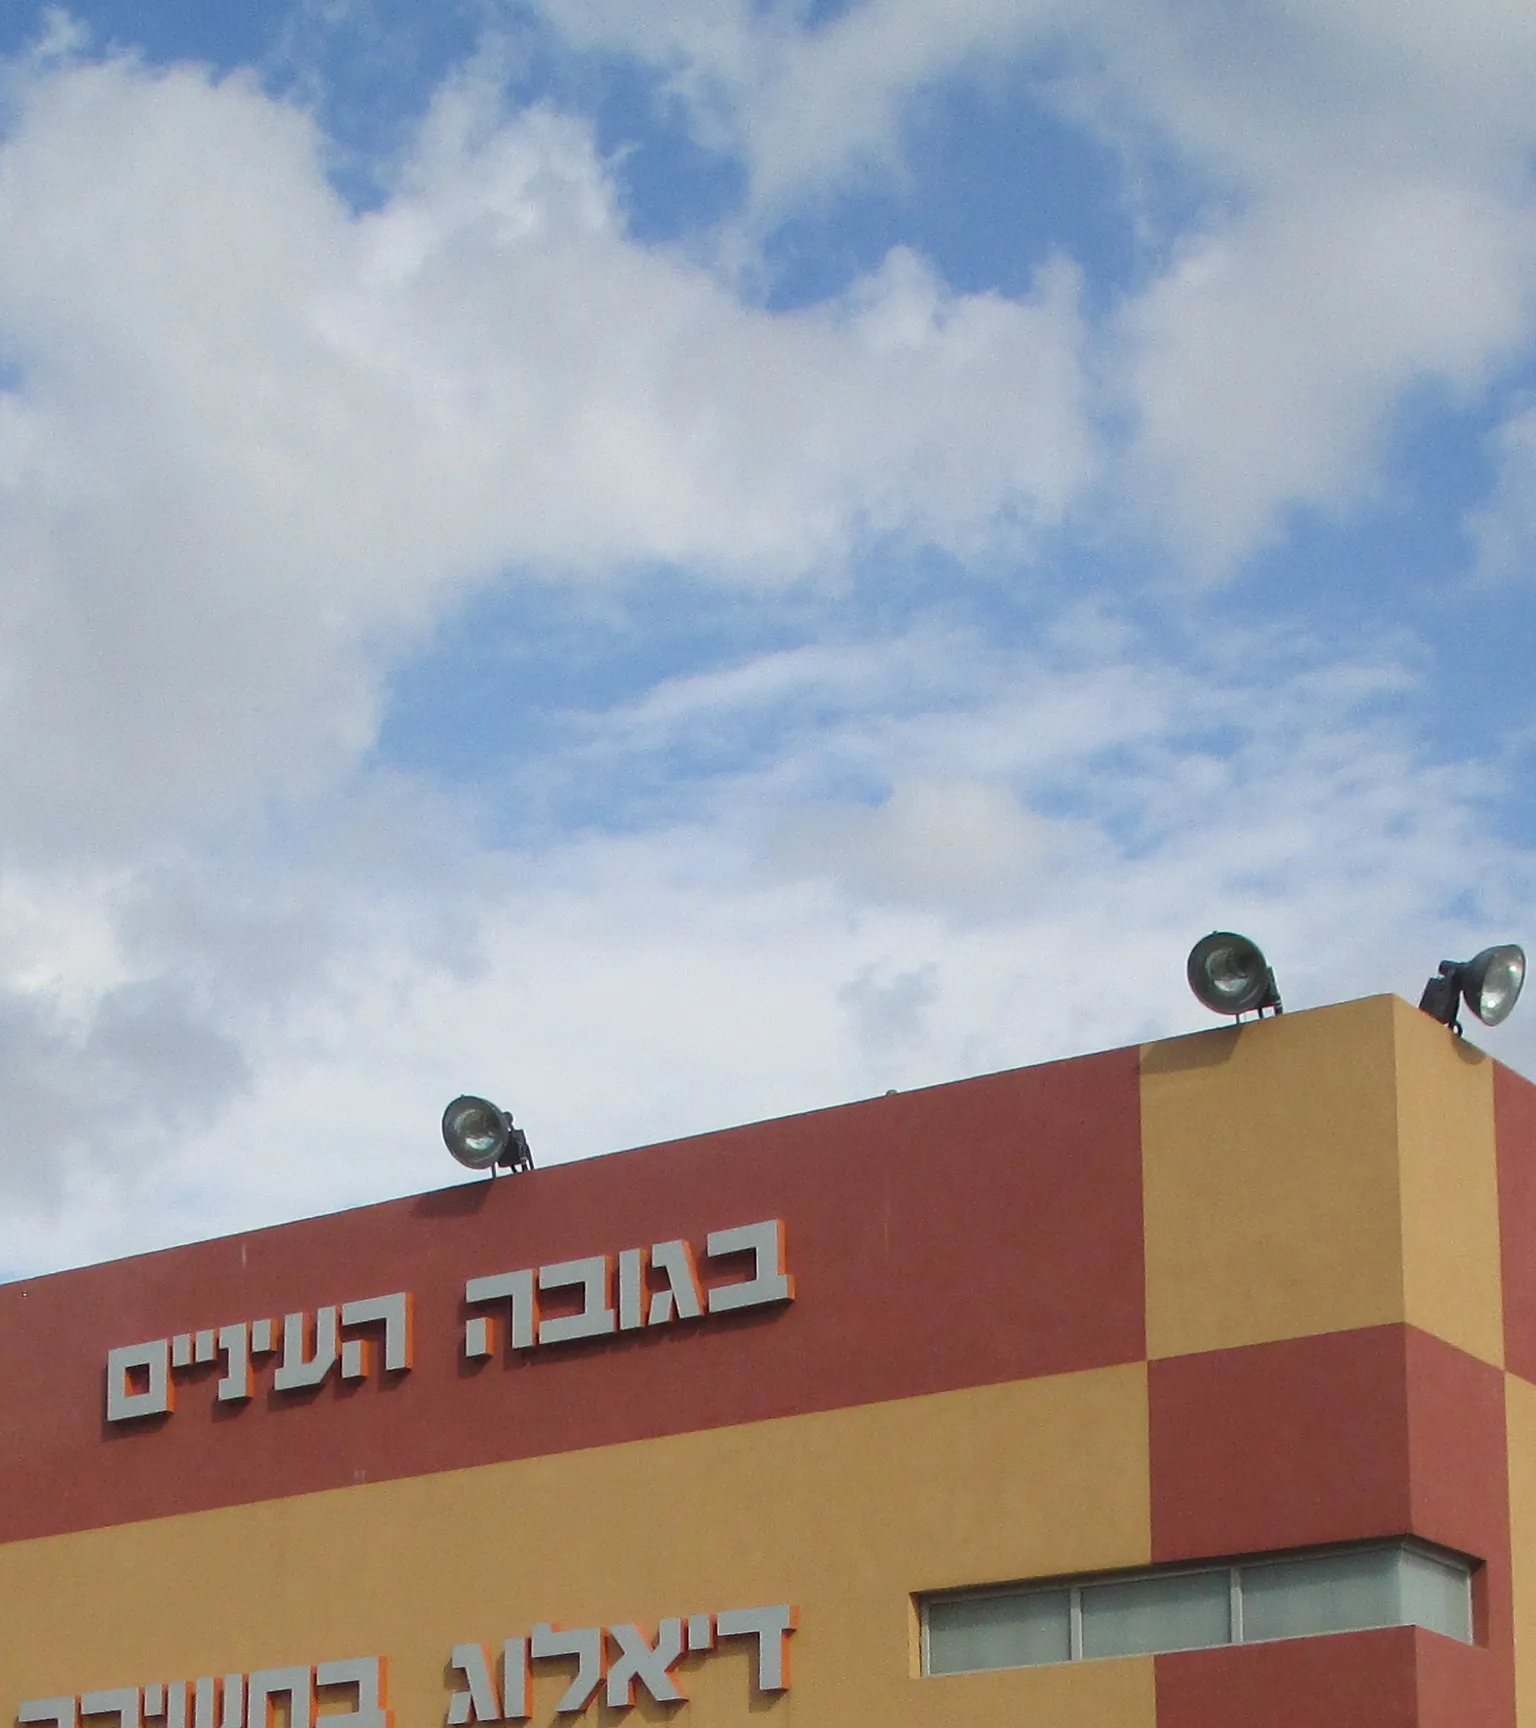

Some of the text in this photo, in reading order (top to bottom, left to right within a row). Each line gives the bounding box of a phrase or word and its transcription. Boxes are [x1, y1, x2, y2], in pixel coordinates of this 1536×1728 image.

[107, 1219, 795, 1422] בגובה העיניים
[446, 1604, 799, 1726] דיאלוג
